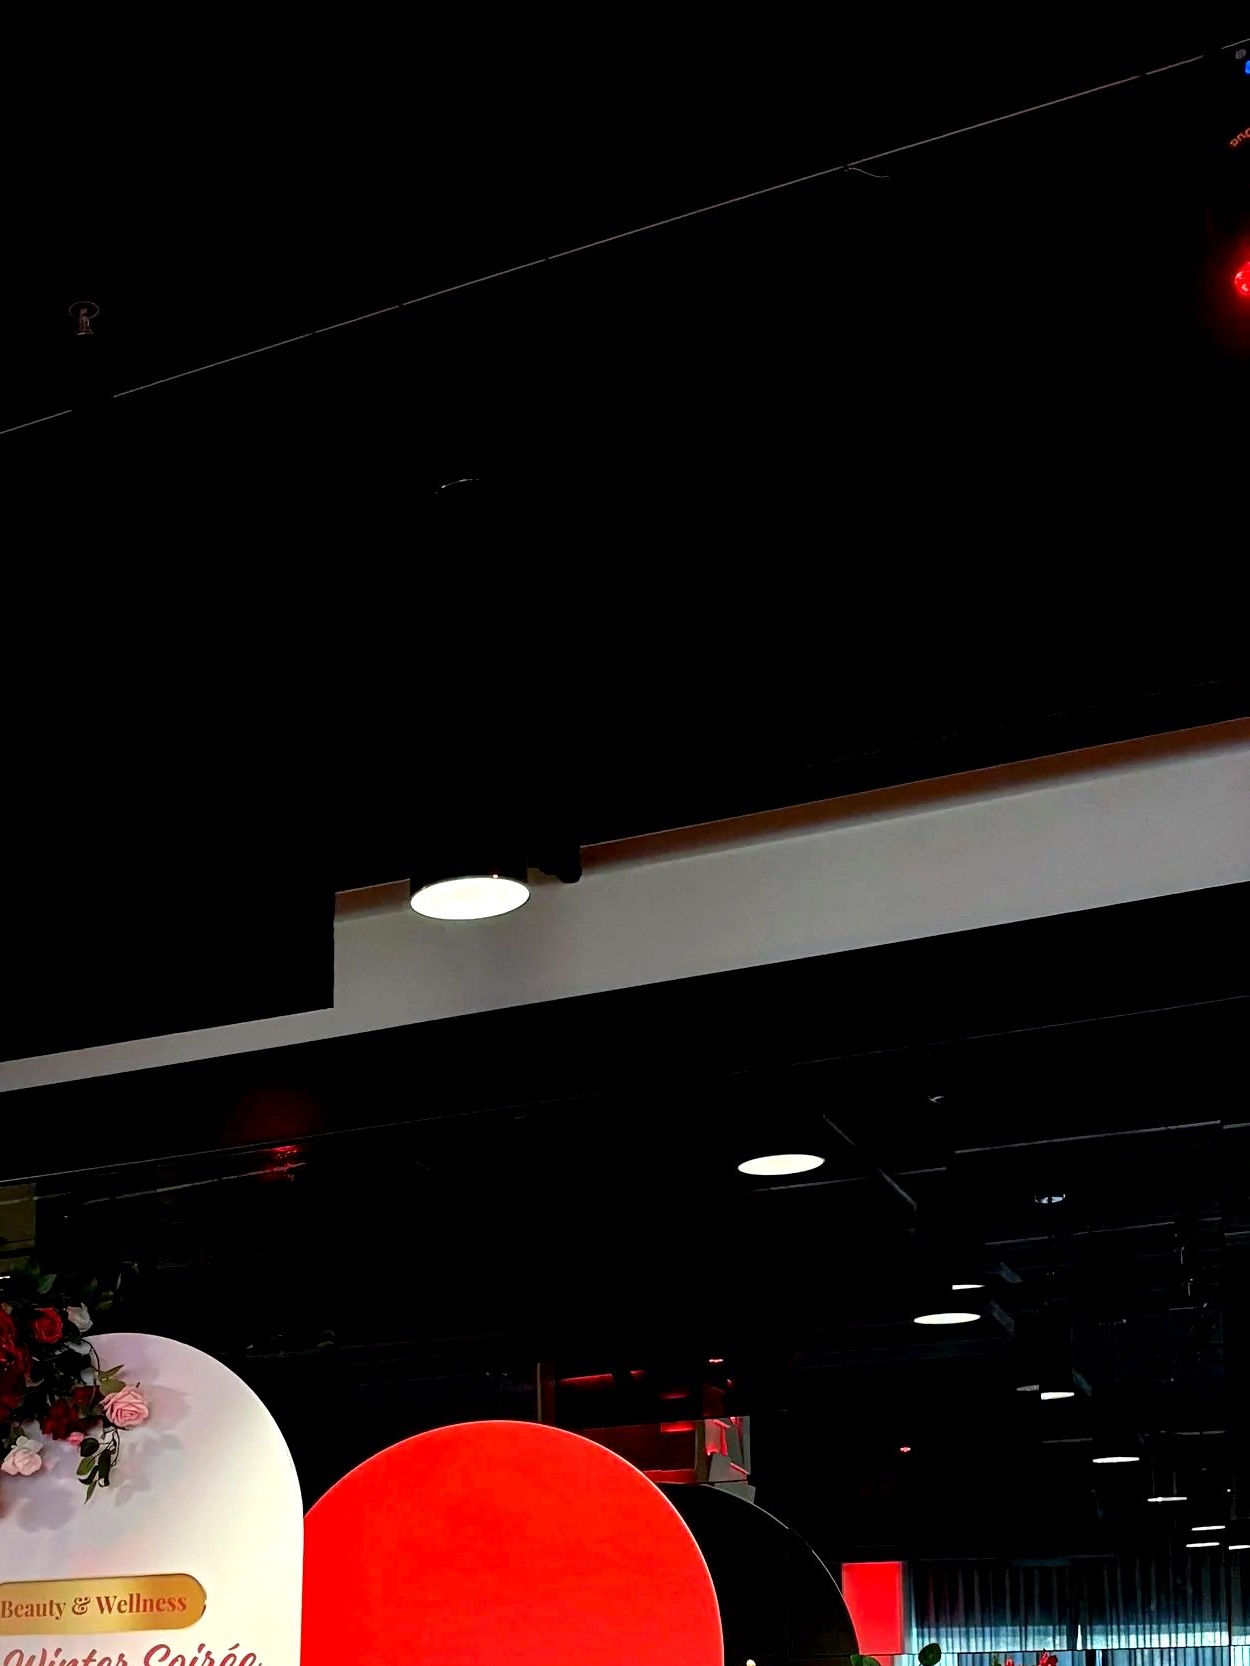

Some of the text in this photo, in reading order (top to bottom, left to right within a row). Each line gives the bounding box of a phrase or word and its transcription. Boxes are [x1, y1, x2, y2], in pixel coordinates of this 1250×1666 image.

[0, 1593, 188, 1621] Beauty & Wellness
